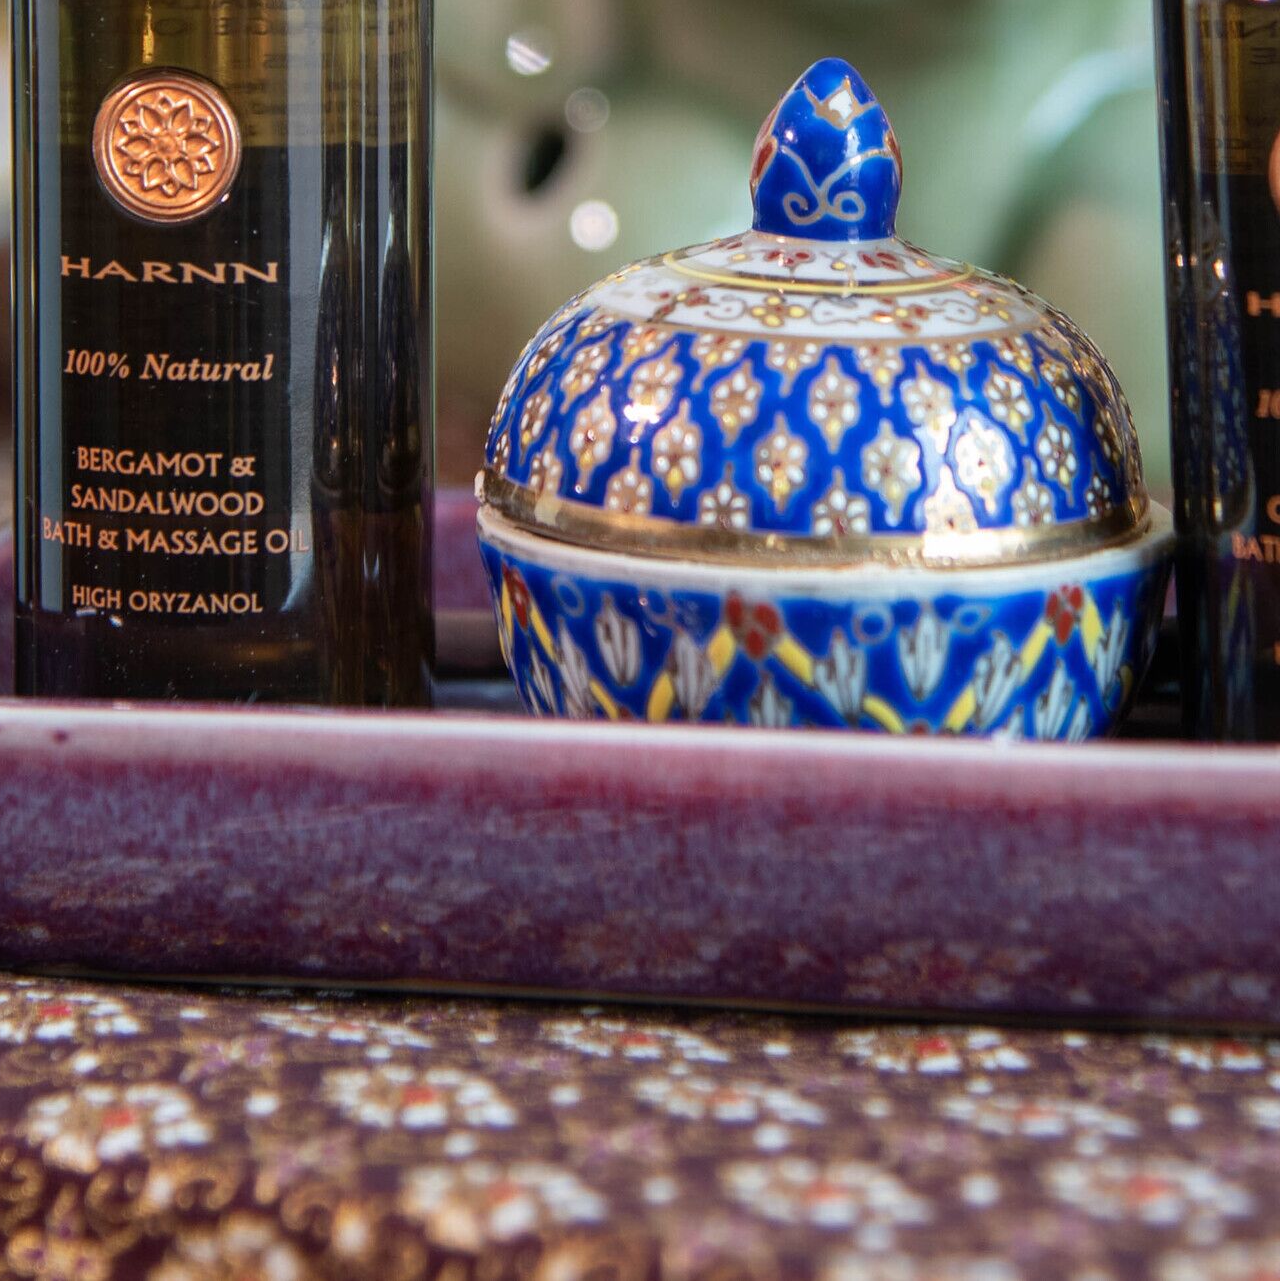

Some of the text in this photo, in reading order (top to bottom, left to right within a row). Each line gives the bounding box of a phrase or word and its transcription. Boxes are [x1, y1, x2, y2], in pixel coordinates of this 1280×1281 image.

[60, 255, 278, 284] HARNN
[64, 349, 274, 382] 100% Natural
[77, 446, 256, 478] BERGAMOT &
[71, 484, 264, 517] SANDALWOOD
[42, 517, 309, 556] BATH & MASSAGE OIL
[72, 585, 263, 615] HIGH ORYZANOL
